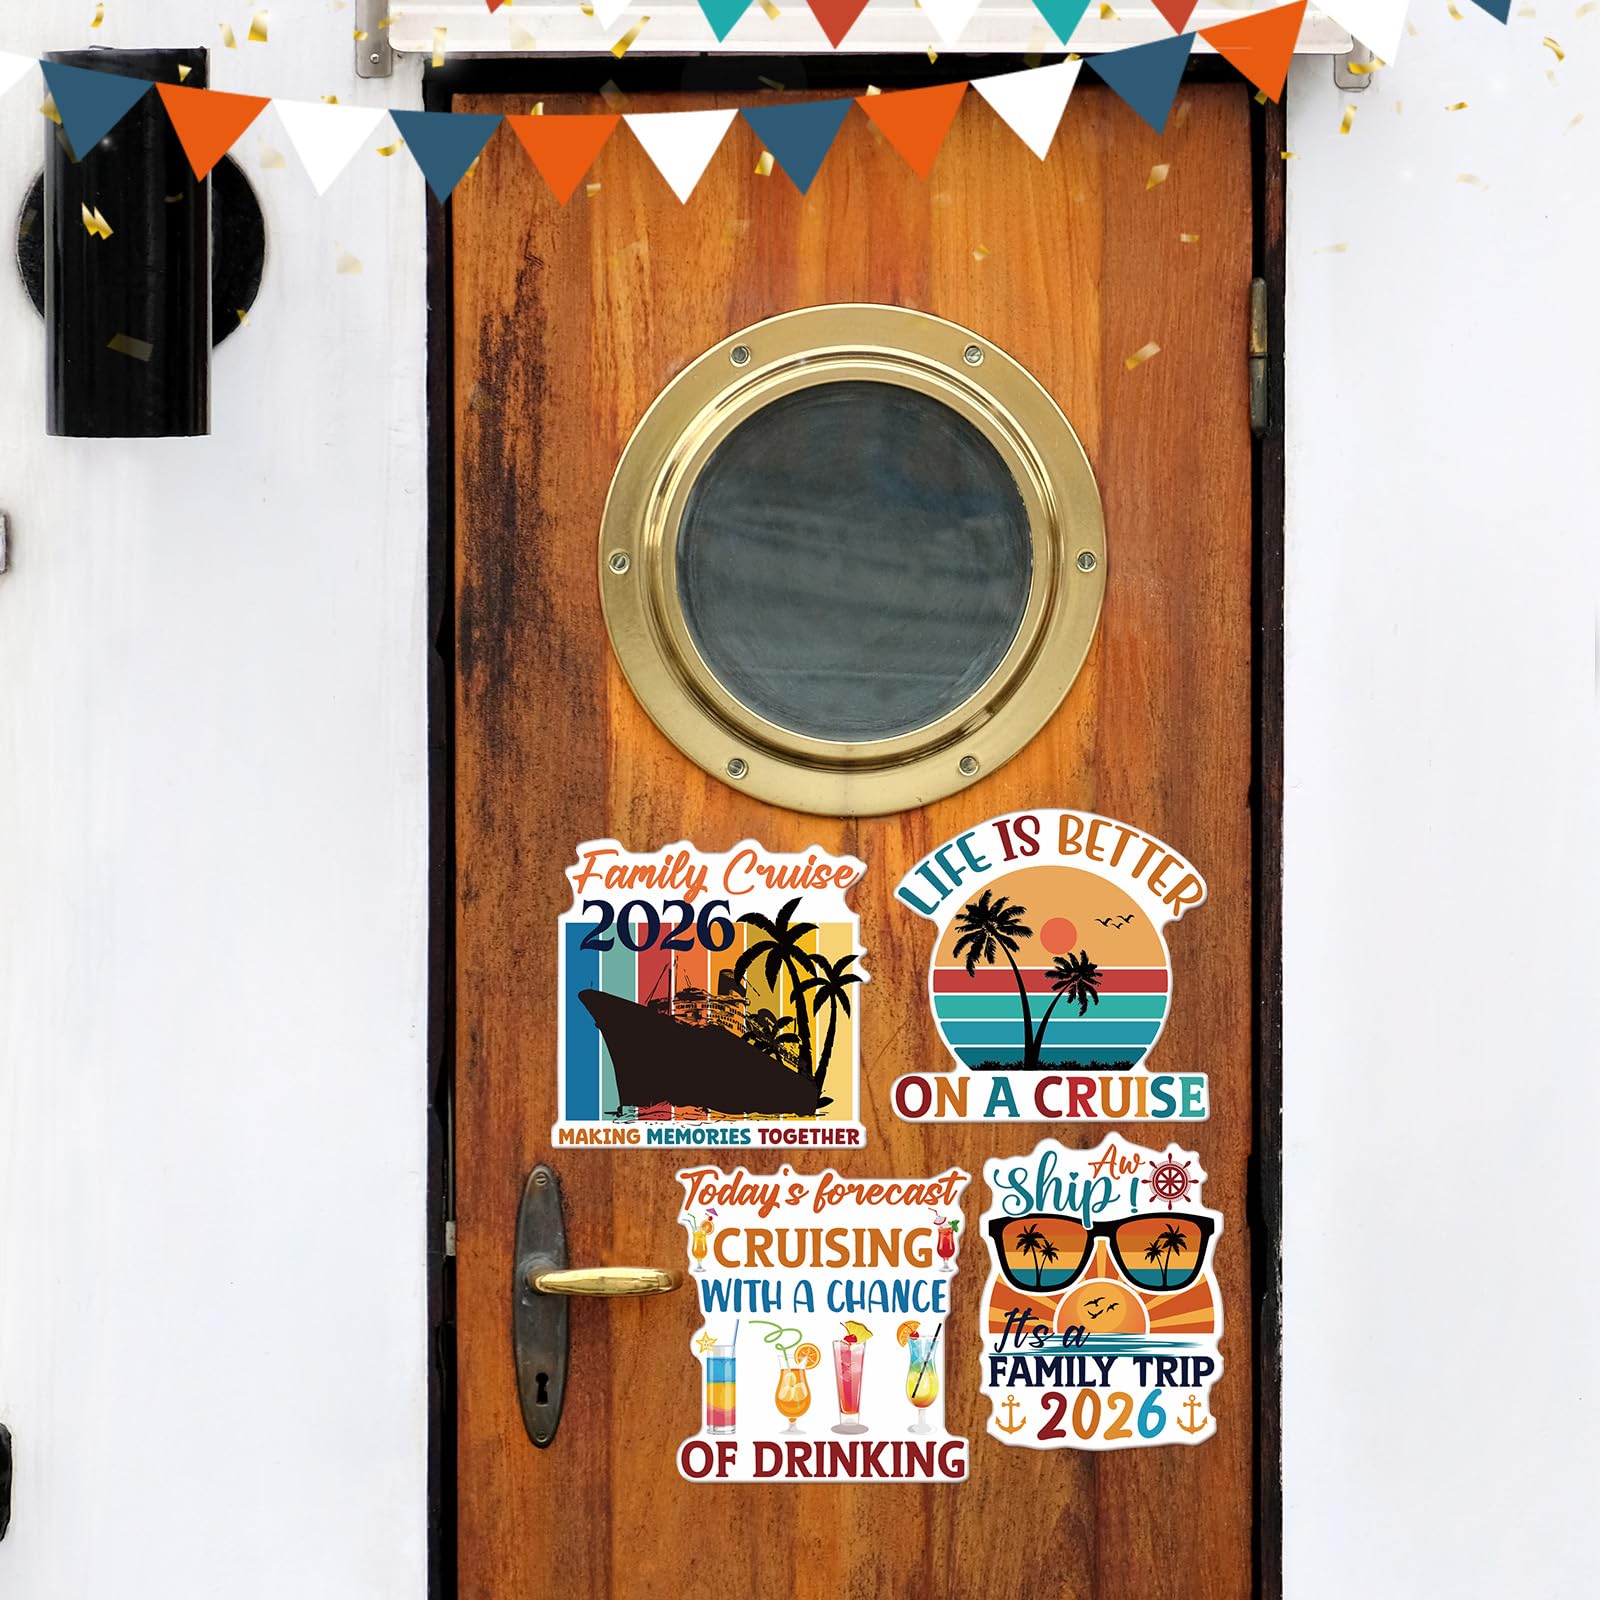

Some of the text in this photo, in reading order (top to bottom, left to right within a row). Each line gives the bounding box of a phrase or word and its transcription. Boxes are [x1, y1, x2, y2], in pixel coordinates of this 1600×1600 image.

[572, 849, 859, 902] Family Cruise
[898, 814, 1203, 917] LIFE IS BETTER
[579, 900, 735, 952] 2026
[895, 1075, 1205, 1118] ON A CRUISE
[559, 1128, 859, 1145] MAKING MEMORIES TOGETHER
[1088, 1143, 1145, 1179] Aw
[680, 1167, 968, 1219] Today's forecast
[713, 1227, 933, 1268] CRUISING
[701, 1278, 947, 1313] WITH A CHANCE
[994, 1307, 1091, 1353] Its a
[988, 1356, 1215, 1387] FAMILY TRIP
[1037, 1388, 1167, 1440] 2026
[681, 1440, 965, 1478] OF DRINKING
